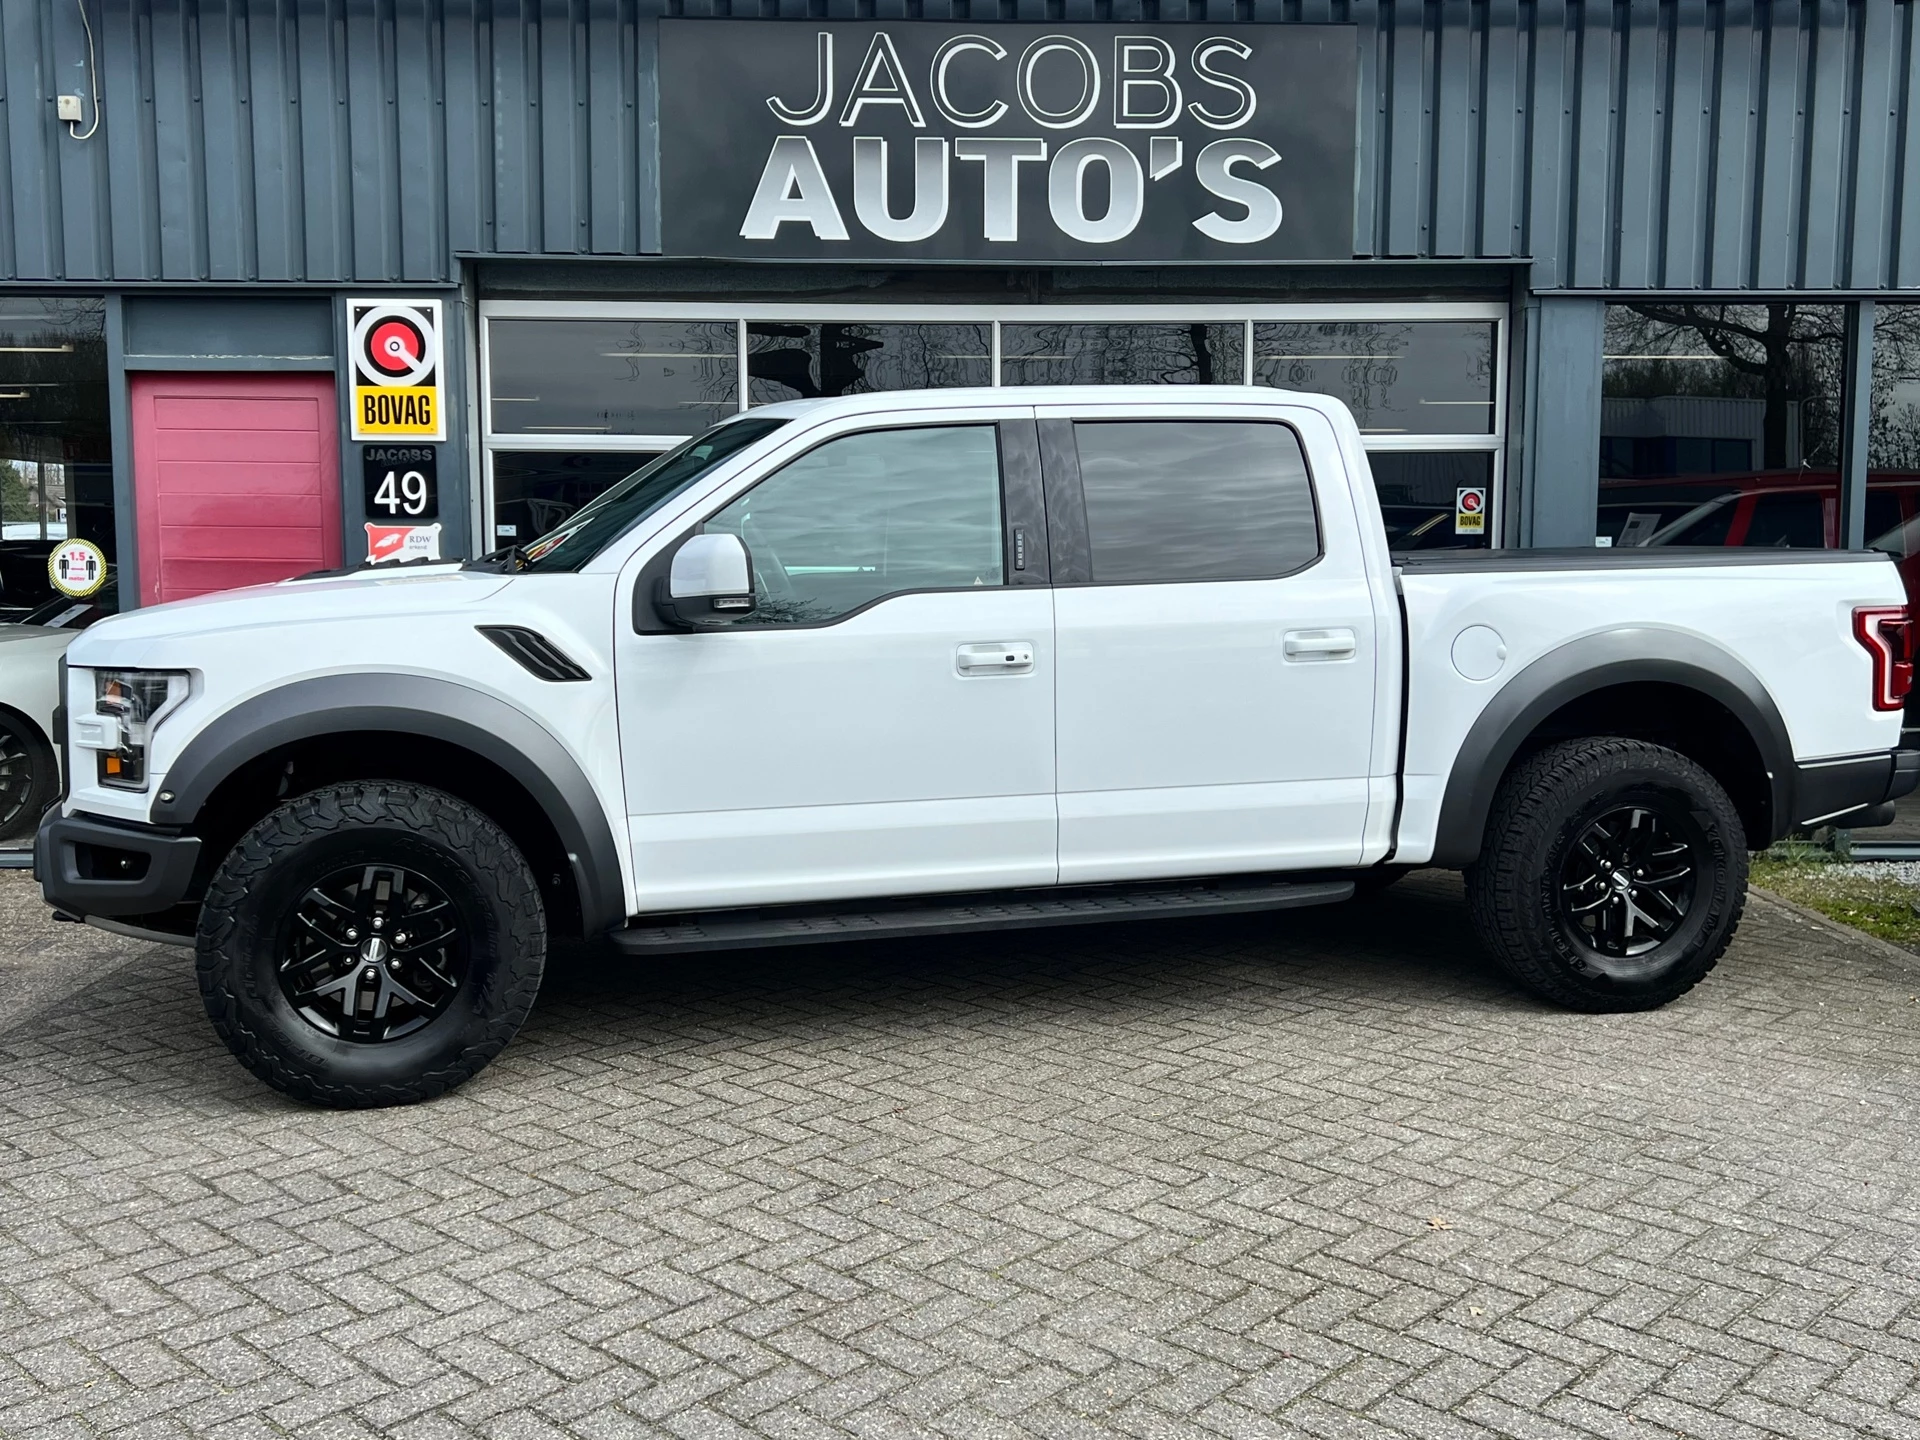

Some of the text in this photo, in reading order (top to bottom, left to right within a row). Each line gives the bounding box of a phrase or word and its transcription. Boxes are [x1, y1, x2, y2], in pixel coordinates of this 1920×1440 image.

[766, 32, 1256, 130] JACOBS
[739, 136, 1283, 244] AUTO'S
[363, 394, 431, 426] BOVAG
[365, 448, 433, 461] JACOBS
[374, 471, 428, 515] 49
[1459, 515, 1481, 526] BOVAG
[409, 535, 432, 543] RDW
[69, 551, 86, 561] 1.5
